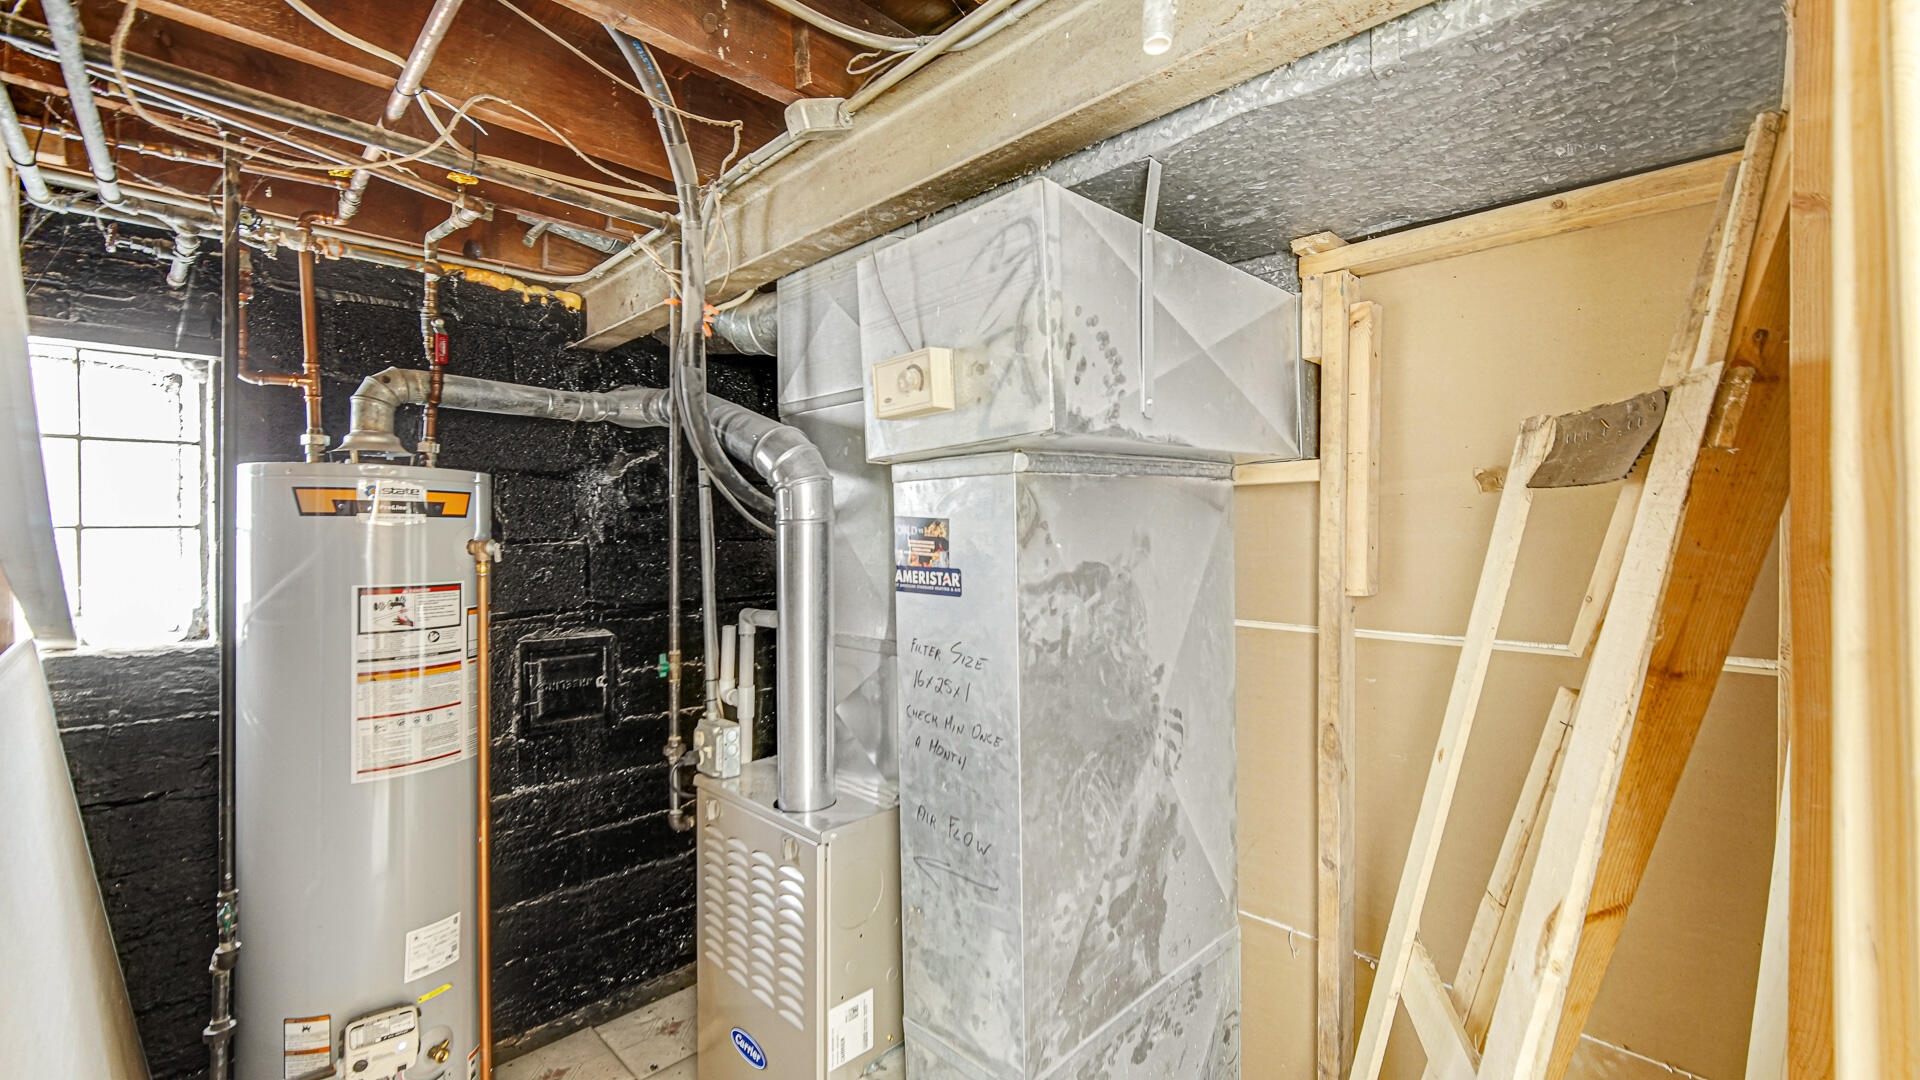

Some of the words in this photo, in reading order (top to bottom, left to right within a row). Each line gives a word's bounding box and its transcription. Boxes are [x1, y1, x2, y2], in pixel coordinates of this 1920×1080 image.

[381, 487, 420, 496] state
[895, 569, 960, 588] AMERISTAR
[911, 638, 941, 661] FILTER
[950, 641, 989, 670] SIZE
[906, 704, 938, 728] CHECK
[944, 715, 965, 734] MIN
[971, 723, 1003, 748] ONCE
[915, 735, 921, 749] A
[929, 738, 967, 771] MONTH
[916, 804, 937, 831] AIR
[948, 815, 992, 856] FLOW
[735, 1033, 761, 1063] Carrier
